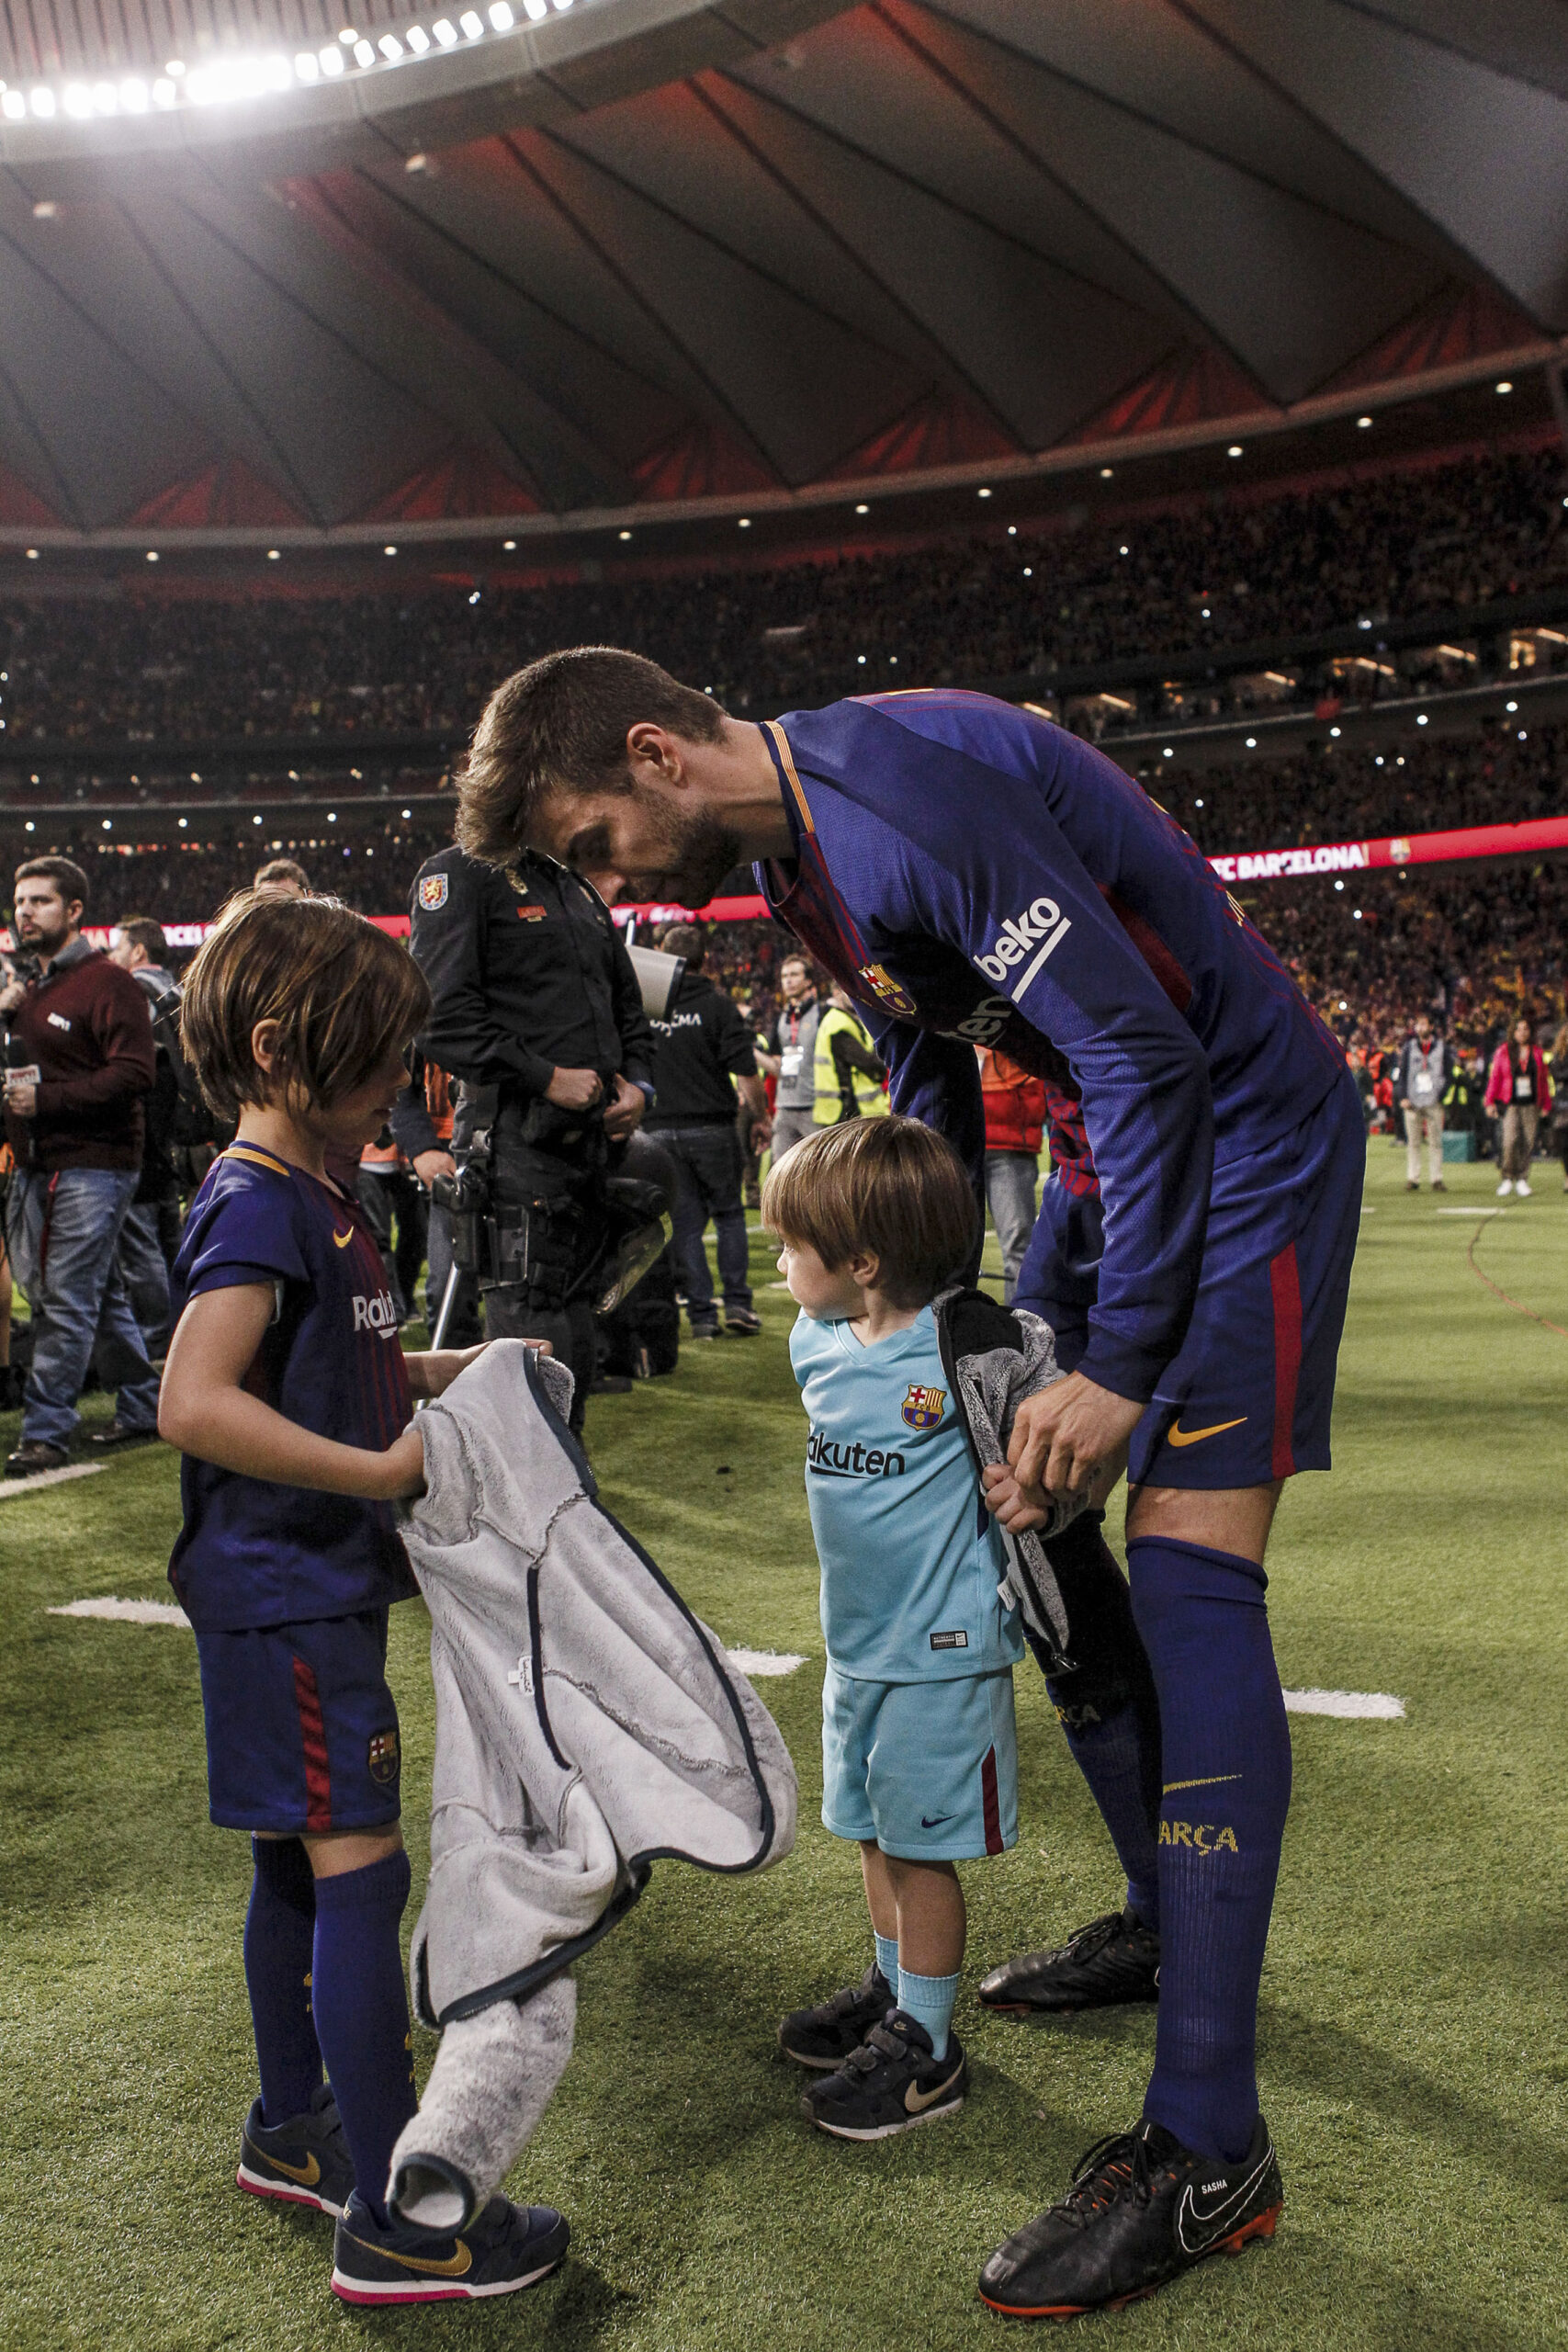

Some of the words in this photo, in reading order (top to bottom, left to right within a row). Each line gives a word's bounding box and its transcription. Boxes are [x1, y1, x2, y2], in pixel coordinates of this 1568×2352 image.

[1237, 844, 1365, 879] BARCELONA
[974, 898, 1061, 981] beko
[807, 1432, 905, 1476] akuten
[1201, 2178, 1228, 2194] SASHA
